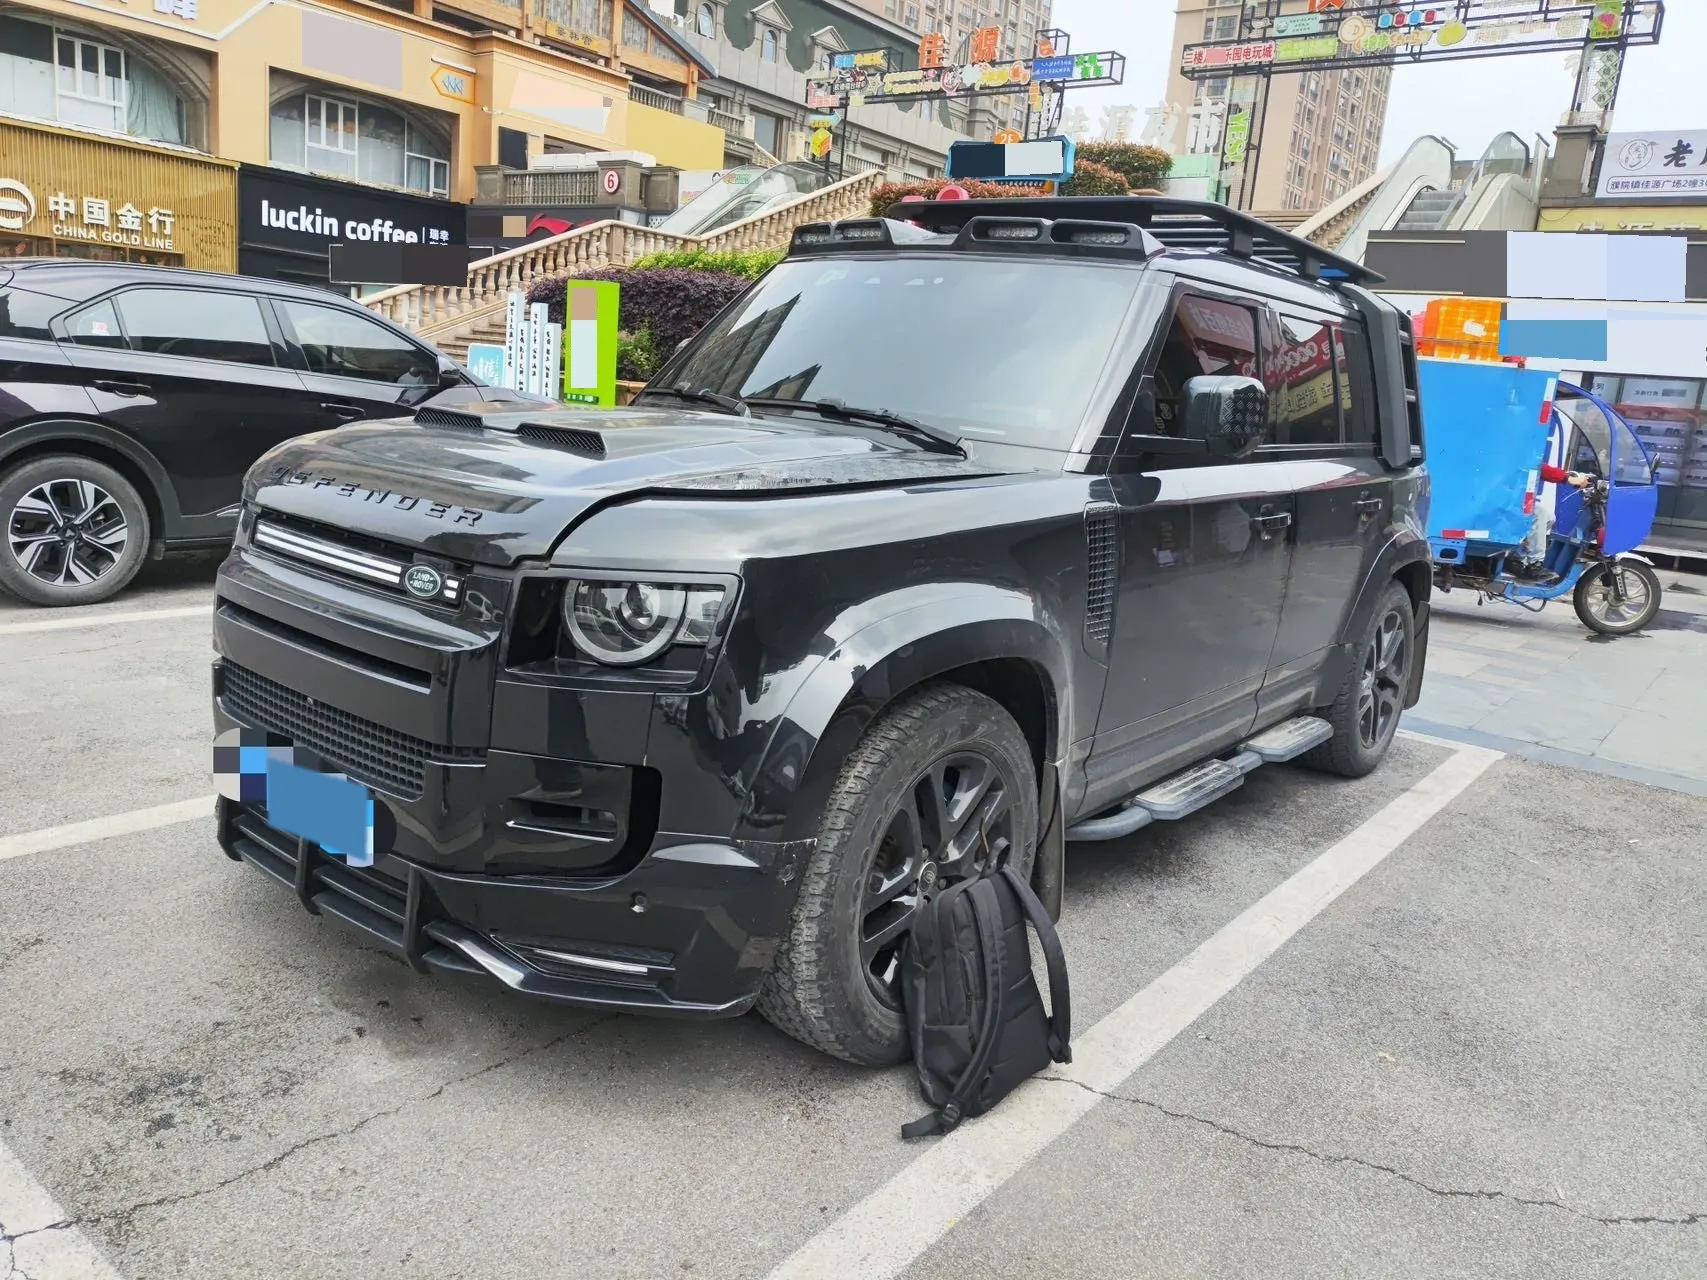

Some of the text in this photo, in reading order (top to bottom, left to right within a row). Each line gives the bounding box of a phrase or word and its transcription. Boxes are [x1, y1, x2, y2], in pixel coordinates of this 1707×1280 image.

[918, 26, 1000, 69] 佳源
[1183, 42, 1274, 65] 三楼乐园电玩城
[1663, 139, 1707, 167] 老
[48, 192, 175, 235] 中国金行
[261, 200, 418, 243] luckin coffee
[53, 224, 173, 249] CHINA GOLD LINE
[429, 228, 449, 242] 瑞幸
[268, 466, 483, 527] DEFENDER
[412, 580, 433, 591] ROVER
[413, 571, 430, 582] LAND
